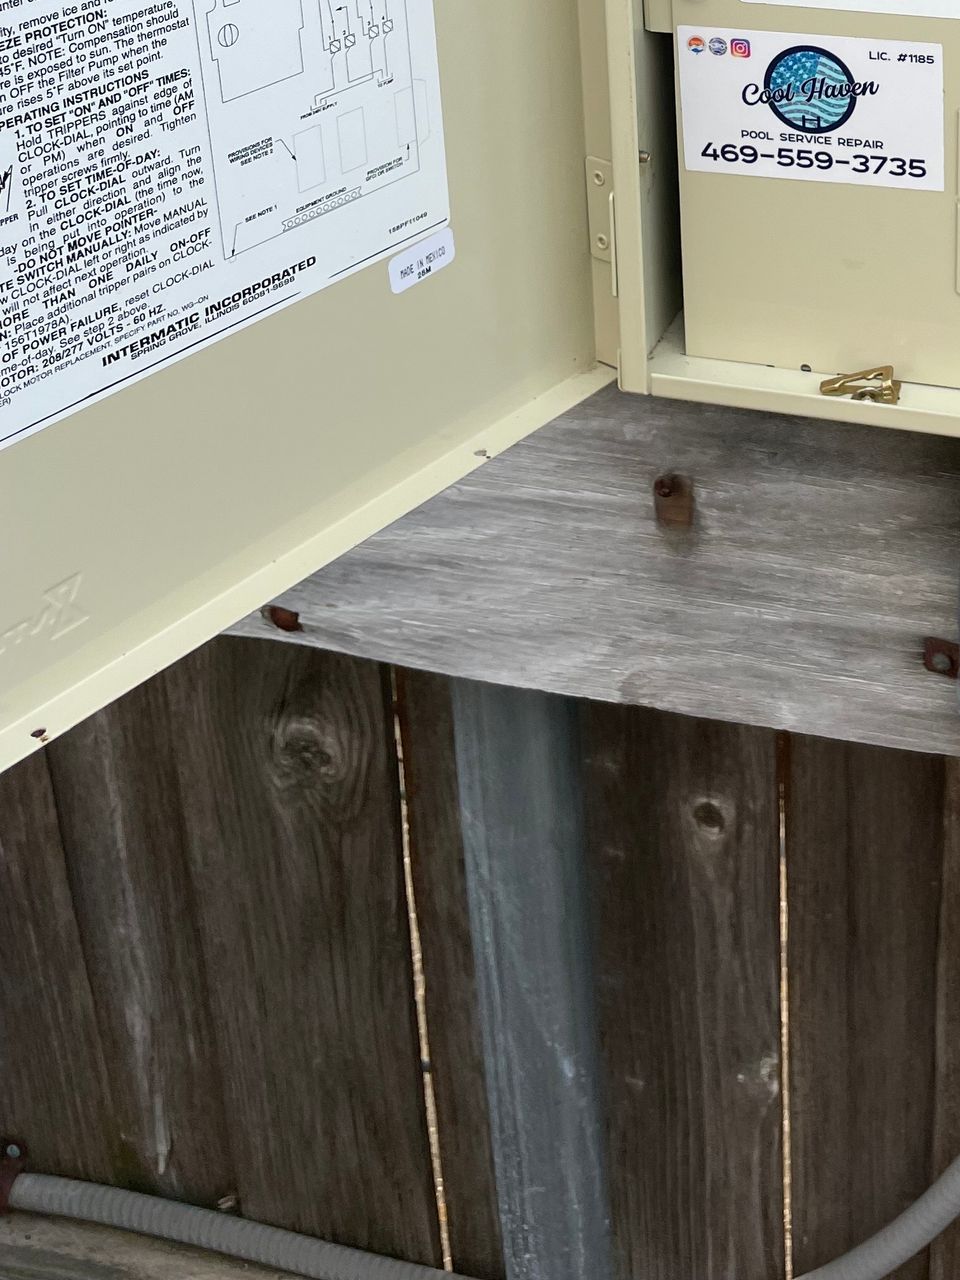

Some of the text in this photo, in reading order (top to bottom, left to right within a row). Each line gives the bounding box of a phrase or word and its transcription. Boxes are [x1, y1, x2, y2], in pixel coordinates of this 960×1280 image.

[869, 51, 935, 64] LIC. #1185
[14, 68, 191, 139] 1. TO SET "ON" AND "OFF" TIMES:
[742, 77, 879, 106] Cool Haven
[701, 141, 927, 178] 469-559-3735
[741, 129, 884, 150] POOL SERVICE REPAIR
[25, 148, 161, 210] 2. TO SET TIME-OF-DAY:
[102, 256, 317, 367] INTERMATIC INCORPORATED
[130, 338, 167, 361] SPRING
[168, 322, 202, 342] GROVE,
[204, 302, 240, 325] ILLINOIS
